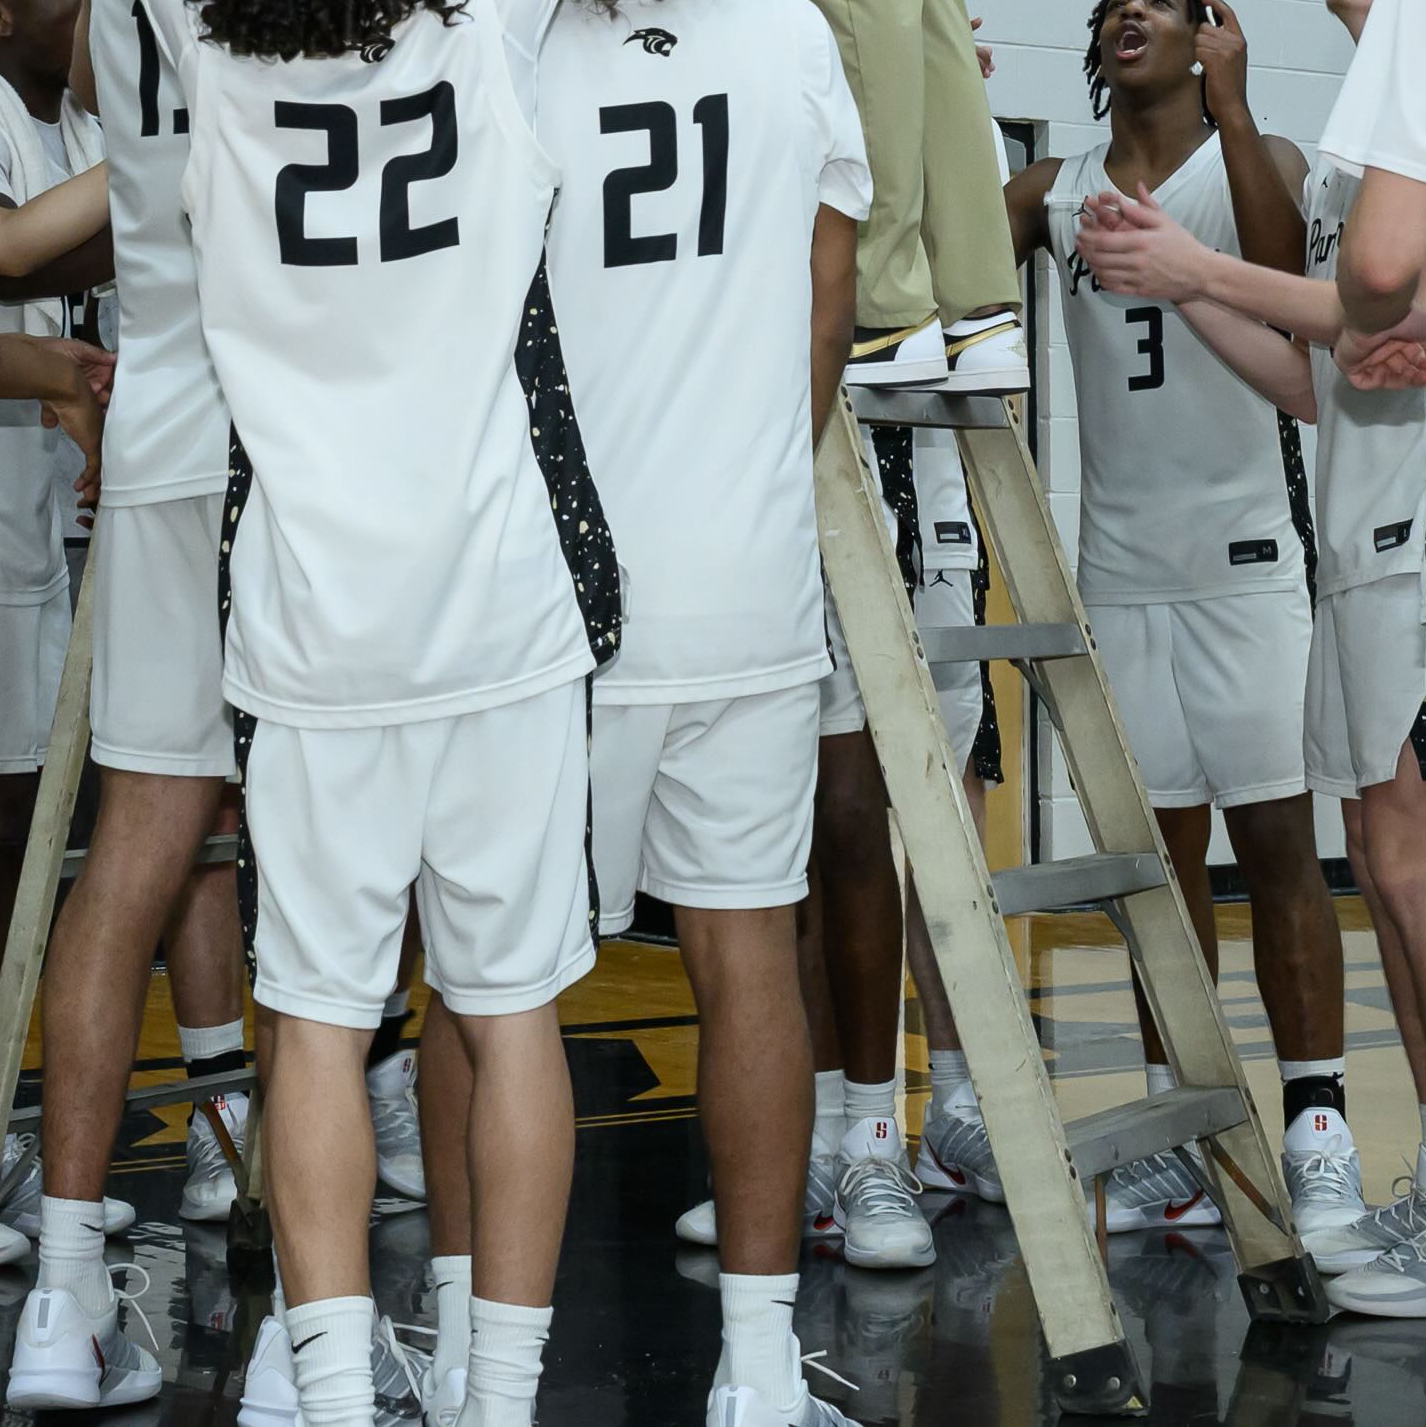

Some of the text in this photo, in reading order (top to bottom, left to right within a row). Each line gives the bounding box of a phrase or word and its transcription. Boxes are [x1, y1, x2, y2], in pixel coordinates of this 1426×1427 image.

[274, 80, 460, 267] 22
[598, 92, 729, 269] 21
[1124, 306, 1165, 392] 3
